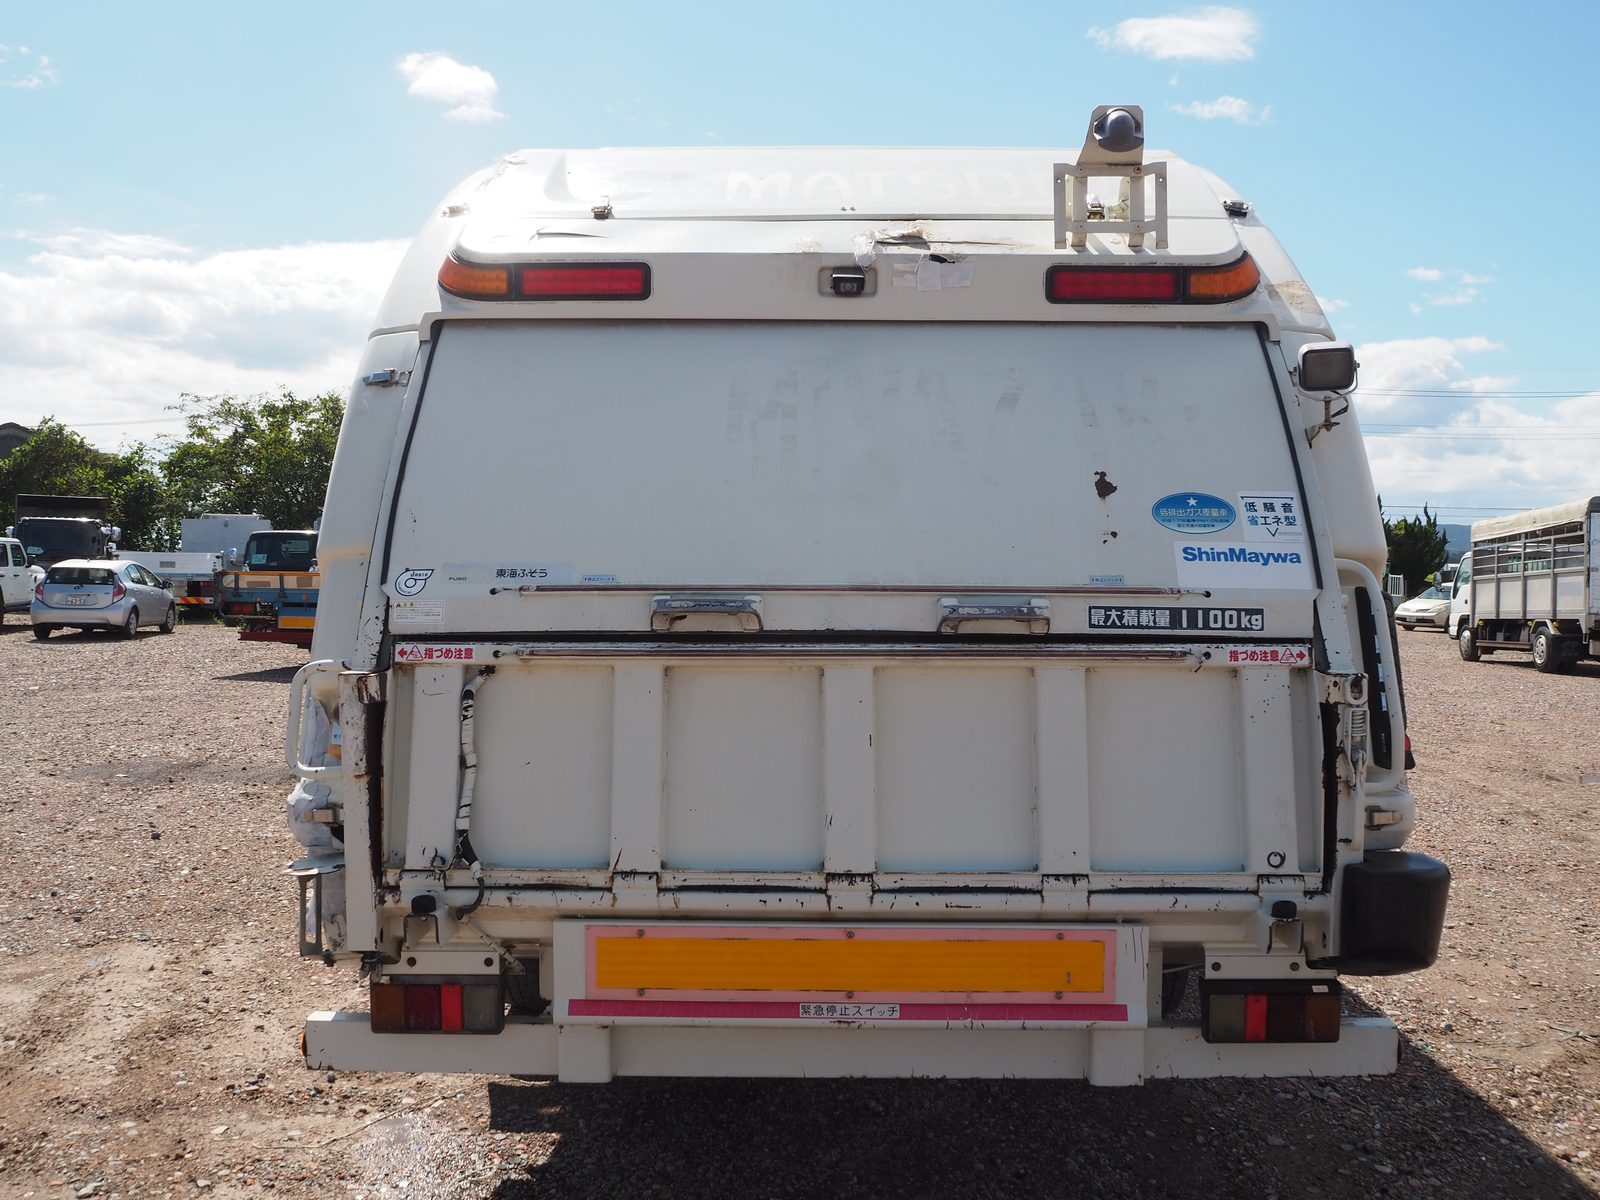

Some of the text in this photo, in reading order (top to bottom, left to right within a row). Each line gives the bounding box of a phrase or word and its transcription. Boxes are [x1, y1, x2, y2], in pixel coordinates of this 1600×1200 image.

[1244, 501, 1295, 514] 低騒音
[1247, 514, 1298, 527] 省エネ型
[1183, 546, 1302, 566] ShinMaywa
[496, 568, 548, 579] 東海ふそう
[1090, 609, 1263, 630] 最大積載量 1100kg
[423, 647, 474, 660] 指づめ注意
[1228, 649, 1280, 662] 指づめ注意
[800, 1004, 899, 1017] 緊急停止スイッチ
